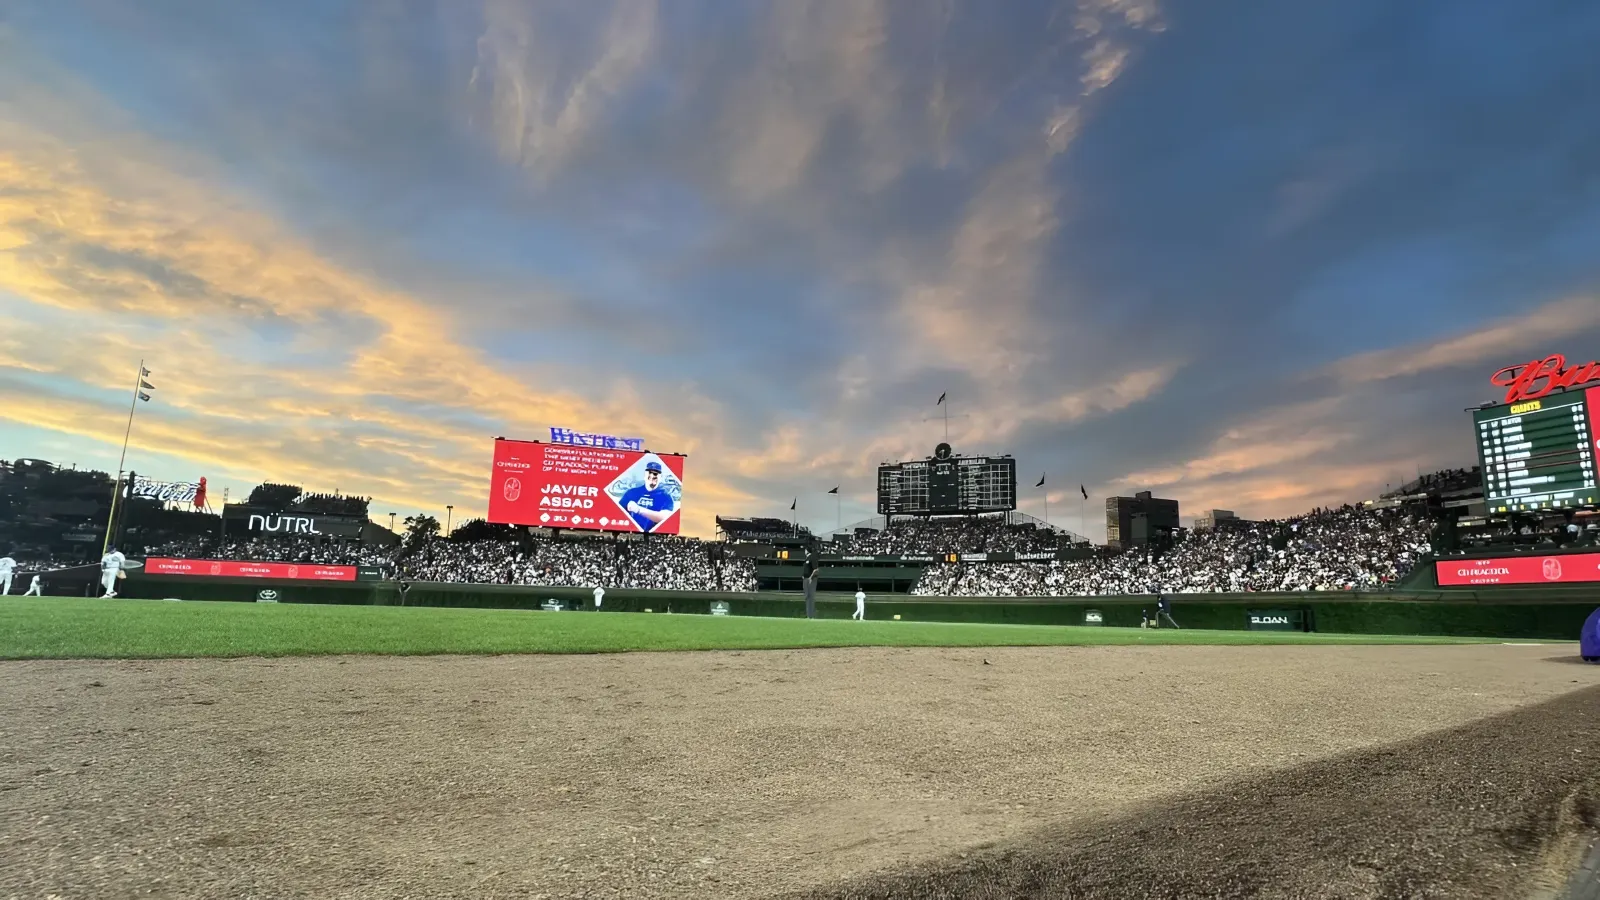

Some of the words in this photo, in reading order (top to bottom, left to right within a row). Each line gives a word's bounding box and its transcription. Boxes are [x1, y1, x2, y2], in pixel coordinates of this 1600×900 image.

[1491, 353, 1600, 404] Bu
[540, 483, 599, 497] JAVIER
[539, 495, 594, 509] ASSAD
[1250, 616, 1289, 624] SLOAN
